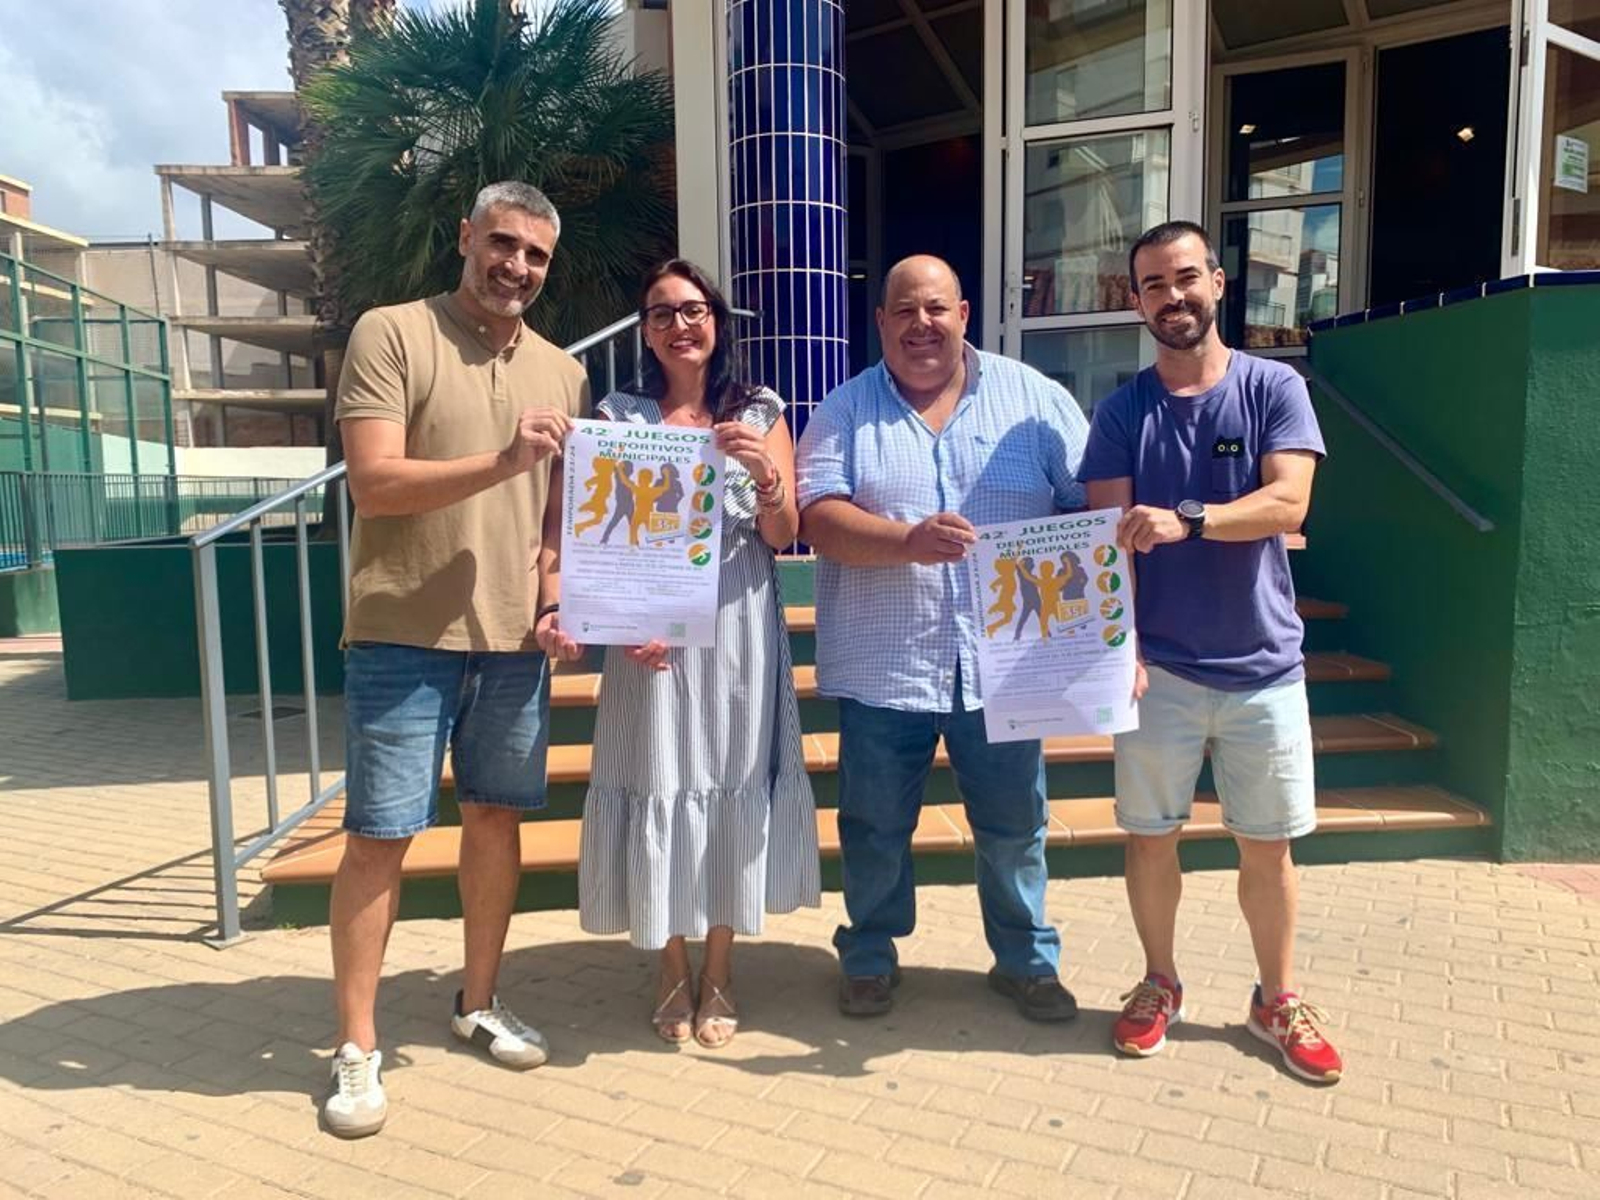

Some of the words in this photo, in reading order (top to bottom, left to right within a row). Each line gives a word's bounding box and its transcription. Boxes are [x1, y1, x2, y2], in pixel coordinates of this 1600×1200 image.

[623, 429, 711, 444] JUEGOS
[597, 439, 694, 454] DEPORTIVOS
[599, 450, 692, 464] MUNICIPALES
[566, 475, 575, 536] TEMPORADA
[1018, 516, 1107, 536] JUEGOS
[995, 531, 1092, 550] DEPORTIVOS
[999, 541, 1091, 559] MUNICIPALES
